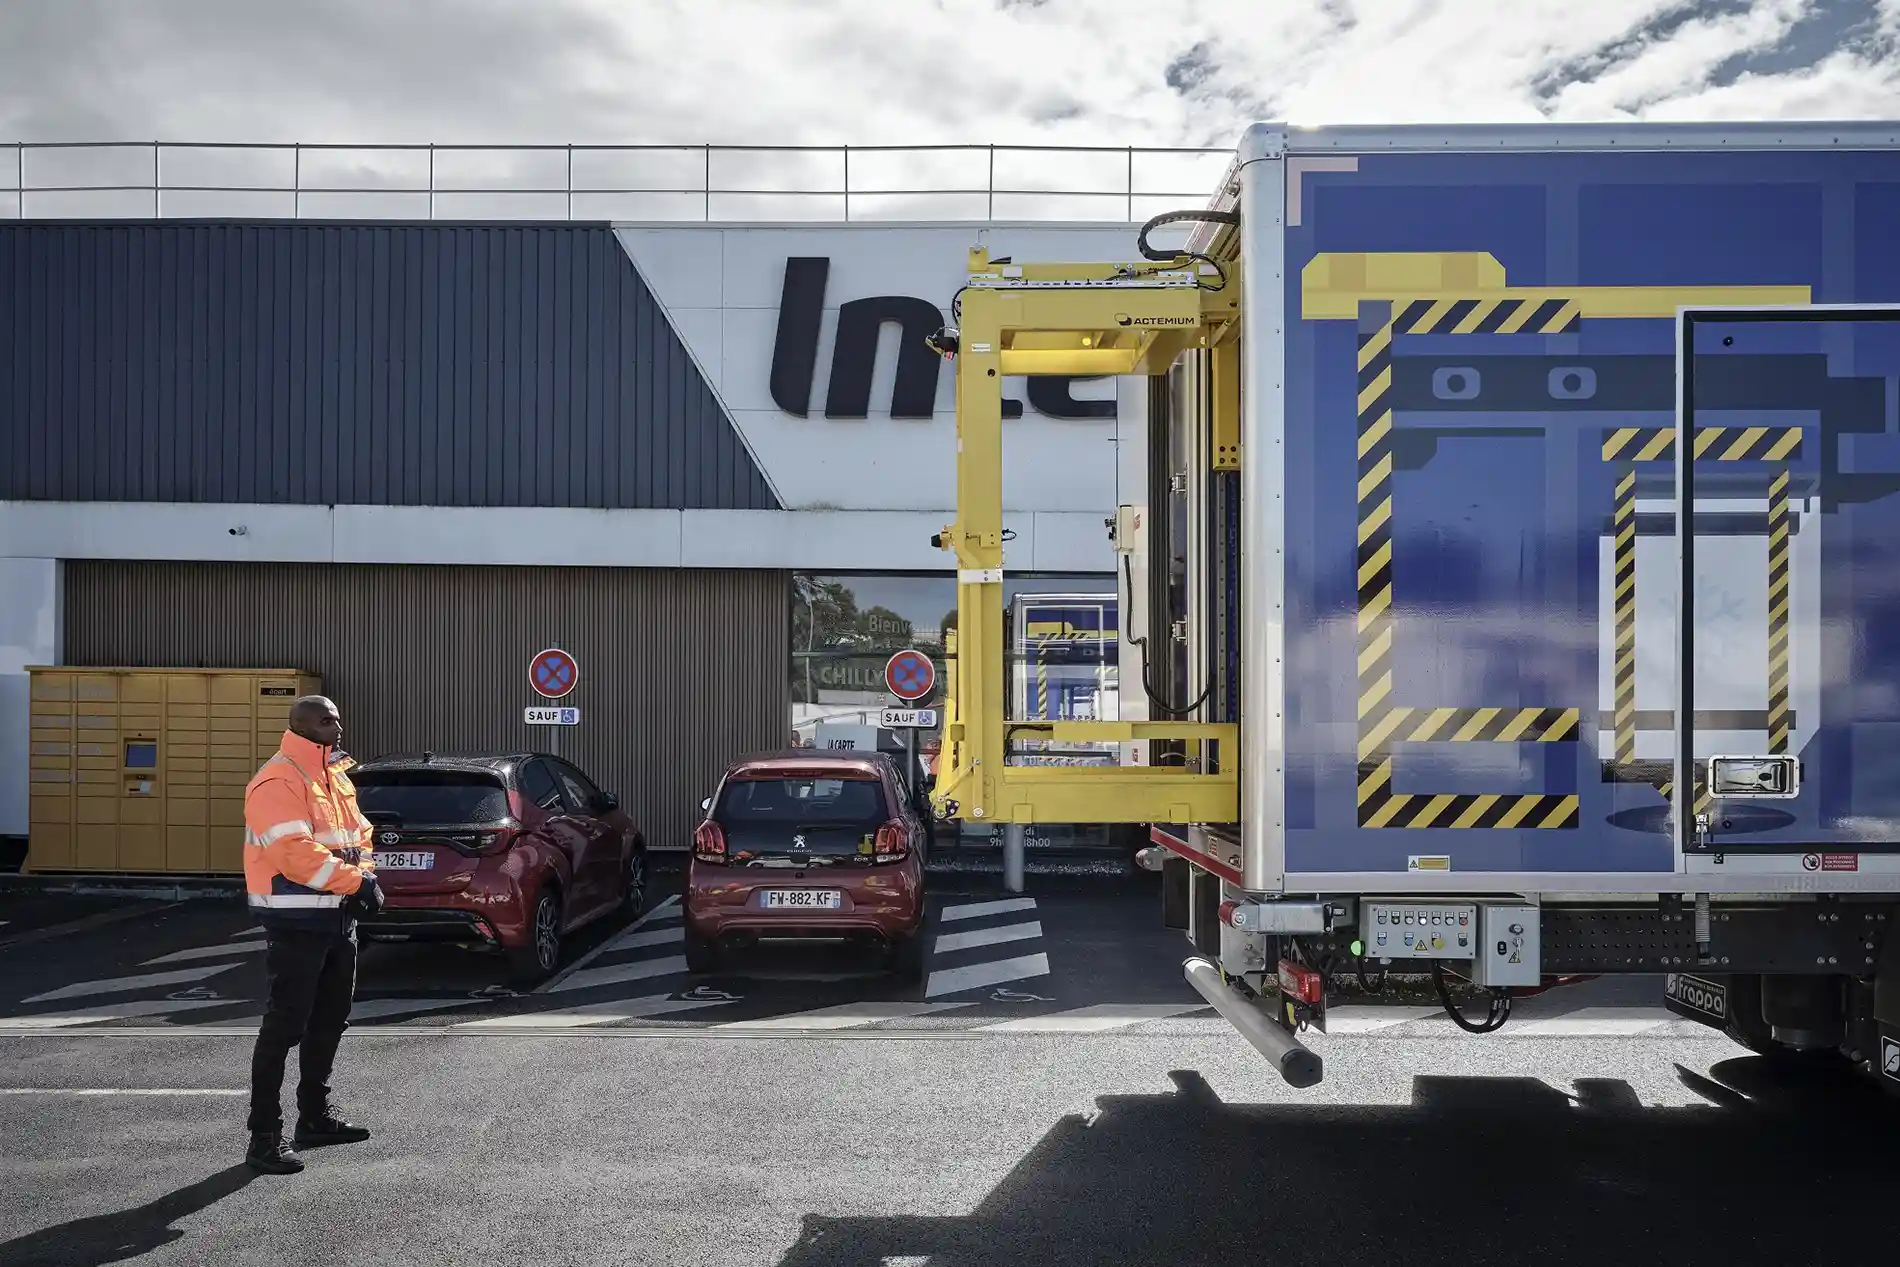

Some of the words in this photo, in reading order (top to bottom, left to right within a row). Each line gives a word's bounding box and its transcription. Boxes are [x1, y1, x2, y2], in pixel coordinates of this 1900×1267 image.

[1133, 316, 1195, 325] ACTEMIUM
[769, 256, 1117, 420] In
[528, 711, 558, 721] SAUF
[885, 712, 915, 723] SAUF
[1000, 826, 1035, 836] sdi
[371, 853, 426, 867] E-126-LT
[769, 892, 831, 905] FW-882-KF
[1678, 976, 1723, 1013] frappa
